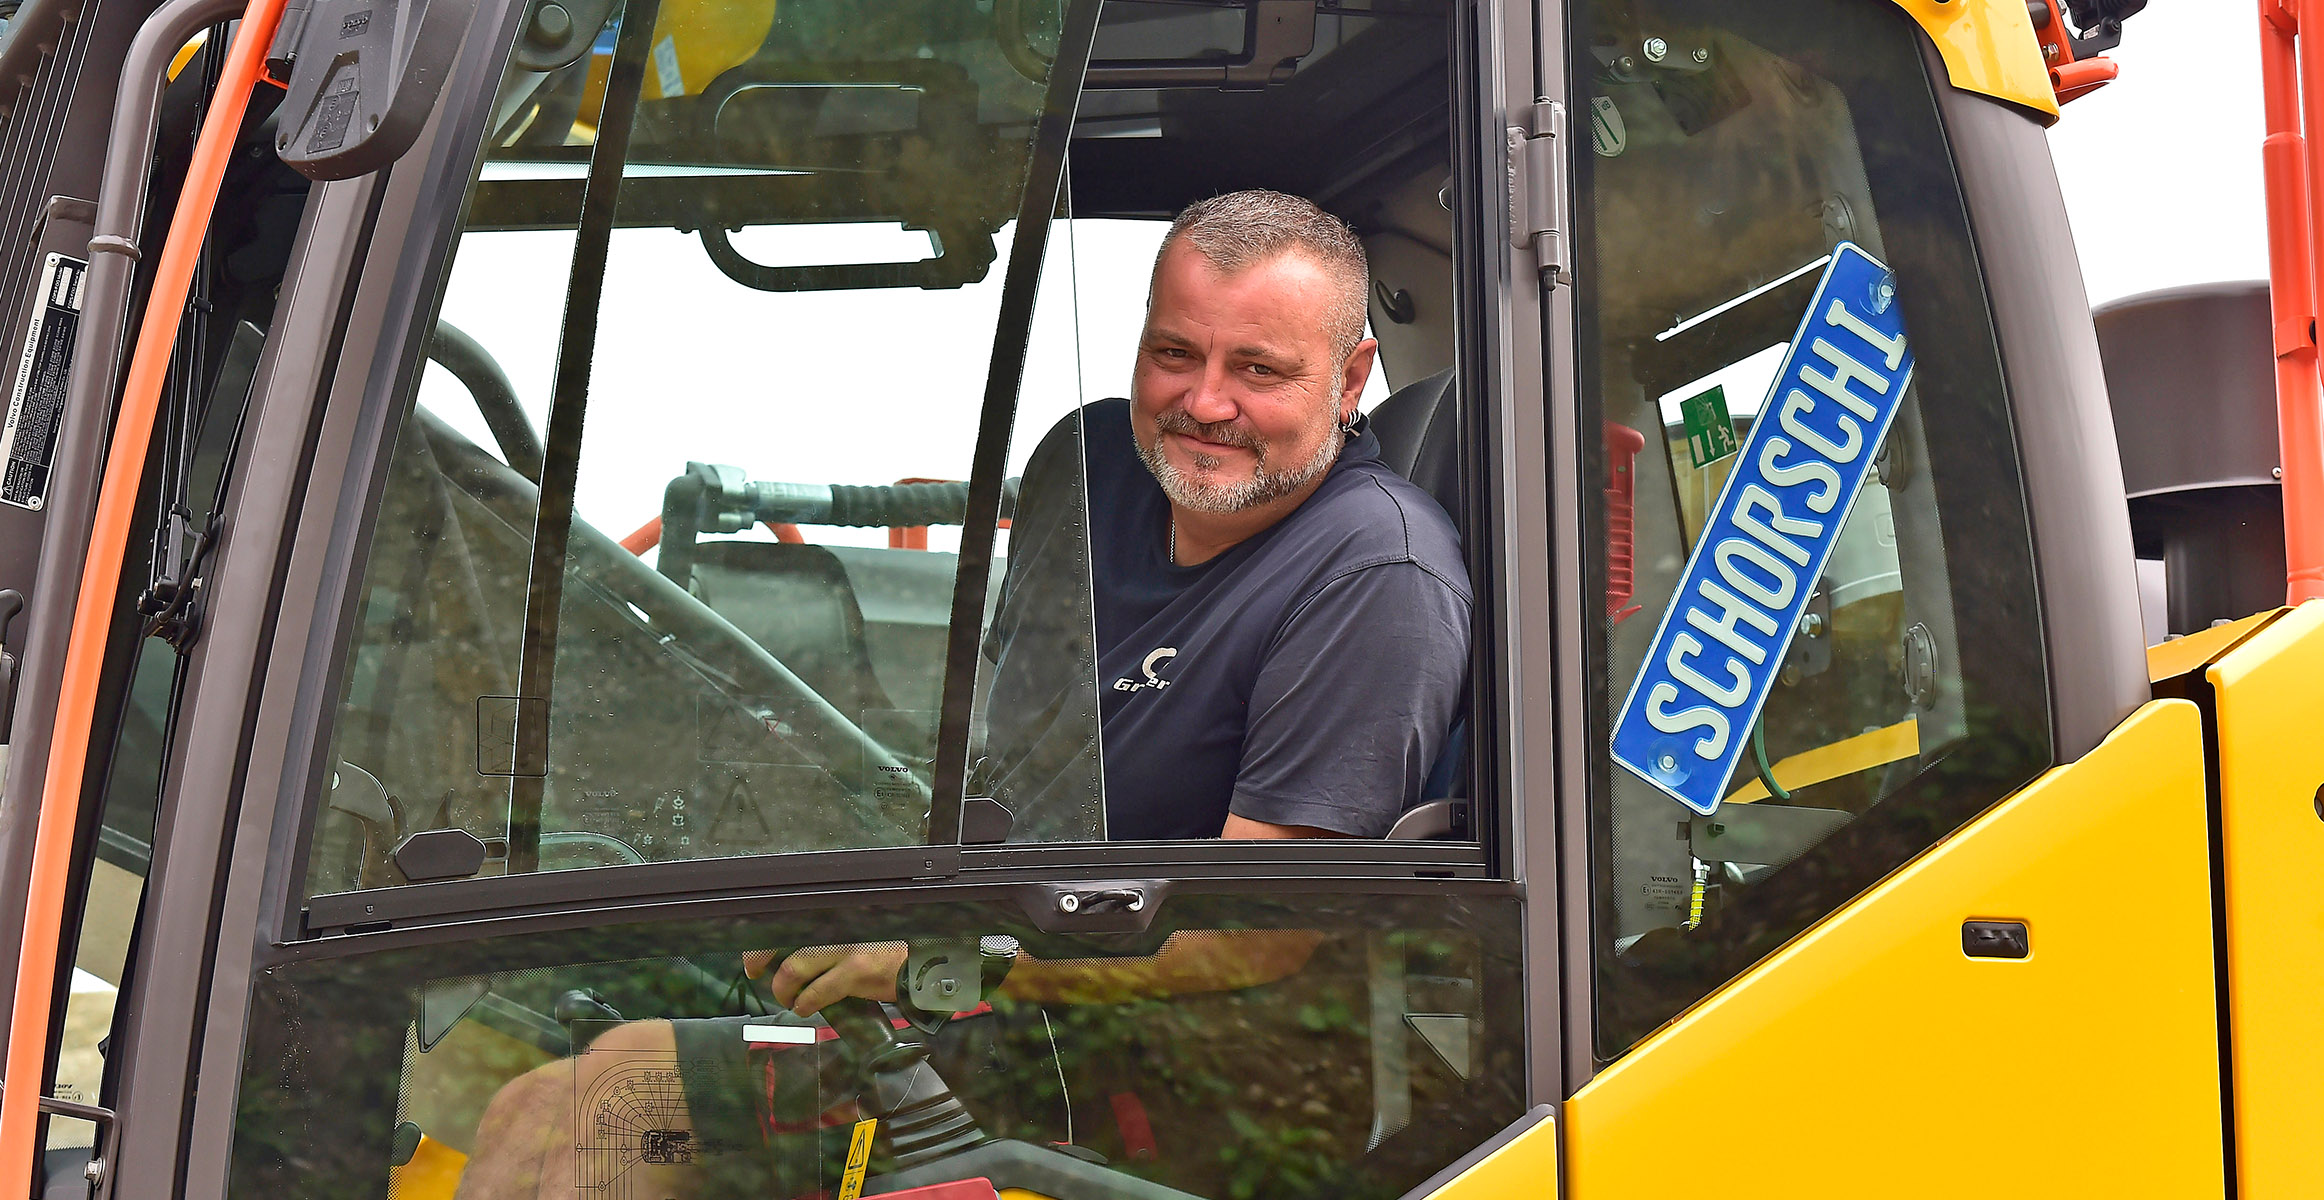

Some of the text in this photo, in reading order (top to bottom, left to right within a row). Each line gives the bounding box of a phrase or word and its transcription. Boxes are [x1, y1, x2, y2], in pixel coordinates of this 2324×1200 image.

[7, 319, 40, 428] Volvo Construction Equipment
[7, 461, 16, 485] CAUTION
[1645, 299, 1908, 761] SCHORSCHI
